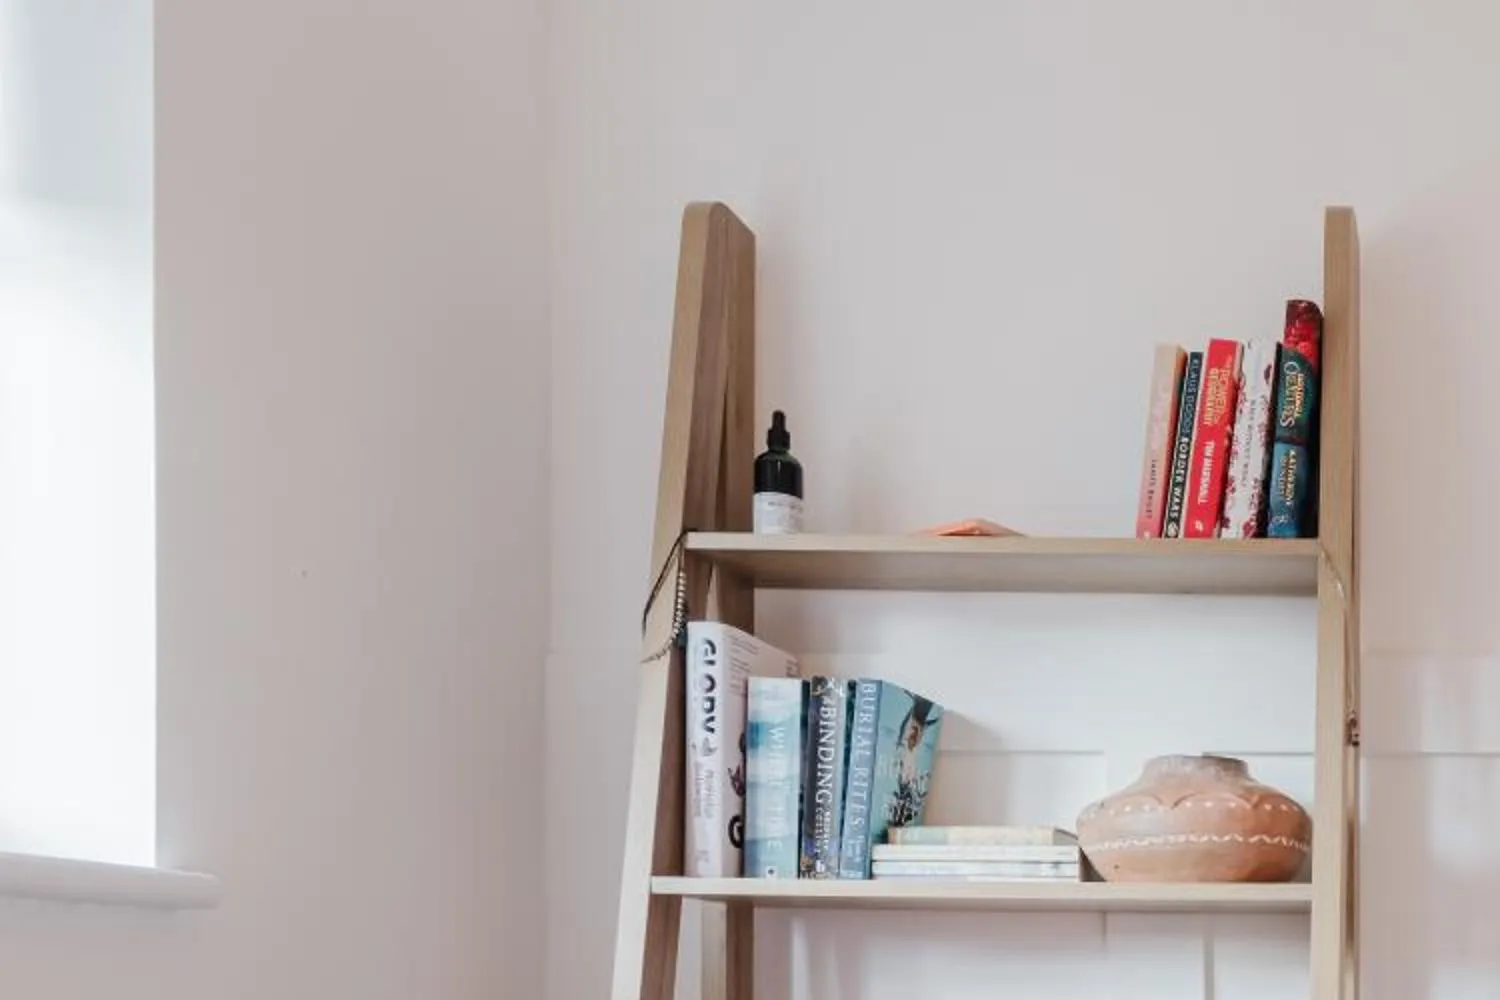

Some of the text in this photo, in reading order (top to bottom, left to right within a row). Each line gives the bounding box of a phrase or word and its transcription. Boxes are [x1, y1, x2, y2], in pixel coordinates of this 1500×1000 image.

[1169, 435, 1189, 519] BORDER WARS
[815, 704, 838, 805] BINDING
[855, 682, 877, 758] BURIAL
[850, 765, 869, 828] RITES
